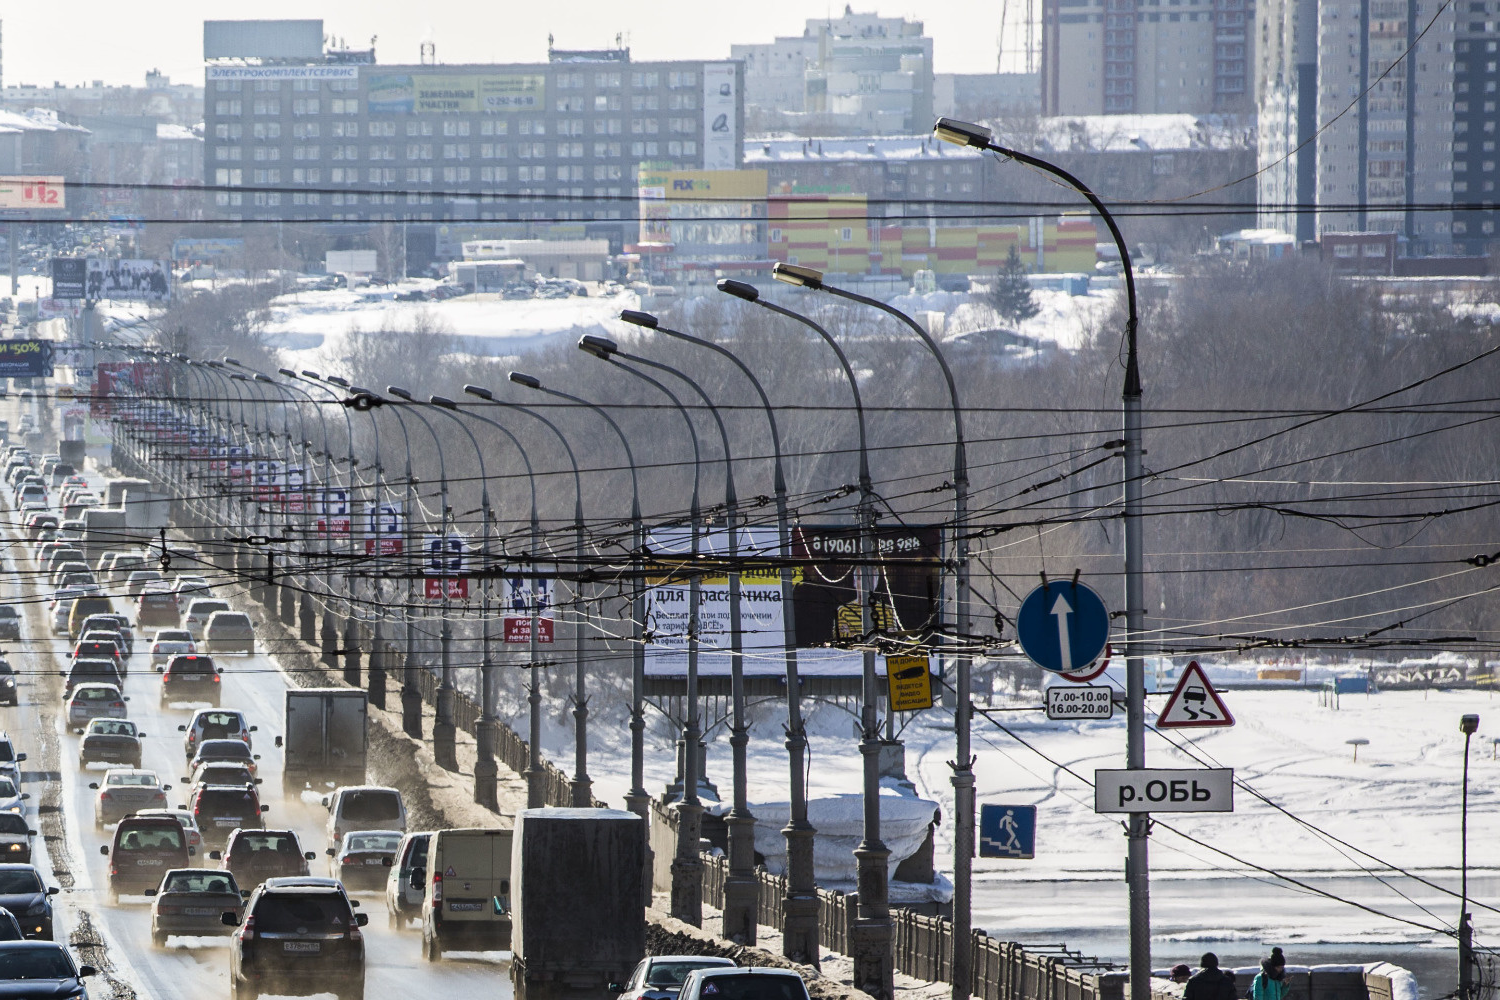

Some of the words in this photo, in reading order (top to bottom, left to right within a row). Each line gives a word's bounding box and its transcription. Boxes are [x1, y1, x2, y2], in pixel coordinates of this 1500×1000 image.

[211, 68, 354, 77] ЭЛЕКТРОКОМПЛЕКТСЕРВИС
[656, 590, 684, 604] для
[1053, 692, 1108, 702] 7.00-10.00
[1050, 704, 1109, 714] 16.00-20.00
[1118, 780, 1211, 807] р.ОБЬ
